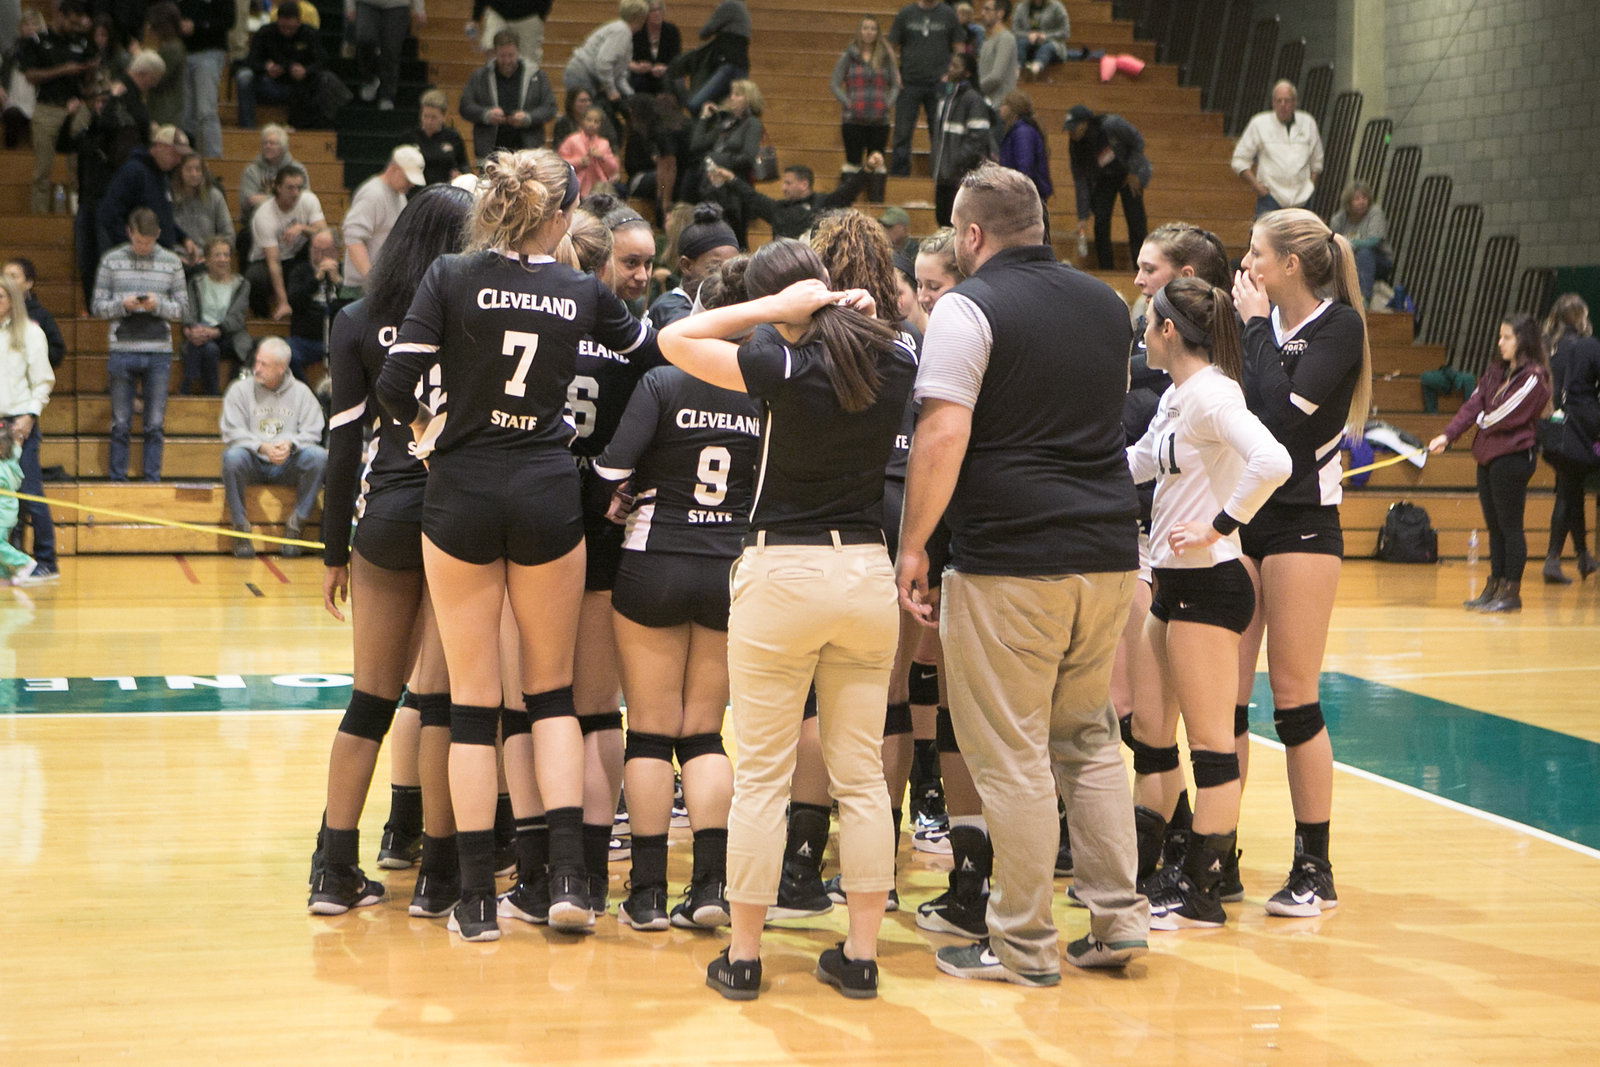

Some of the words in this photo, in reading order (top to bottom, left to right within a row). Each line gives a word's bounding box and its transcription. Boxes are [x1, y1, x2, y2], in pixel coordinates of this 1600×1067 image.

[477, 288, 577, 321] CLEVELAND
[502, 330, 539, 398] 7
[491, 410, 537, 431] STATE
[567, 375, 599, 438] 6
[694, 446, 731, 506] 9
[688, 510, 732, 523] STATE
